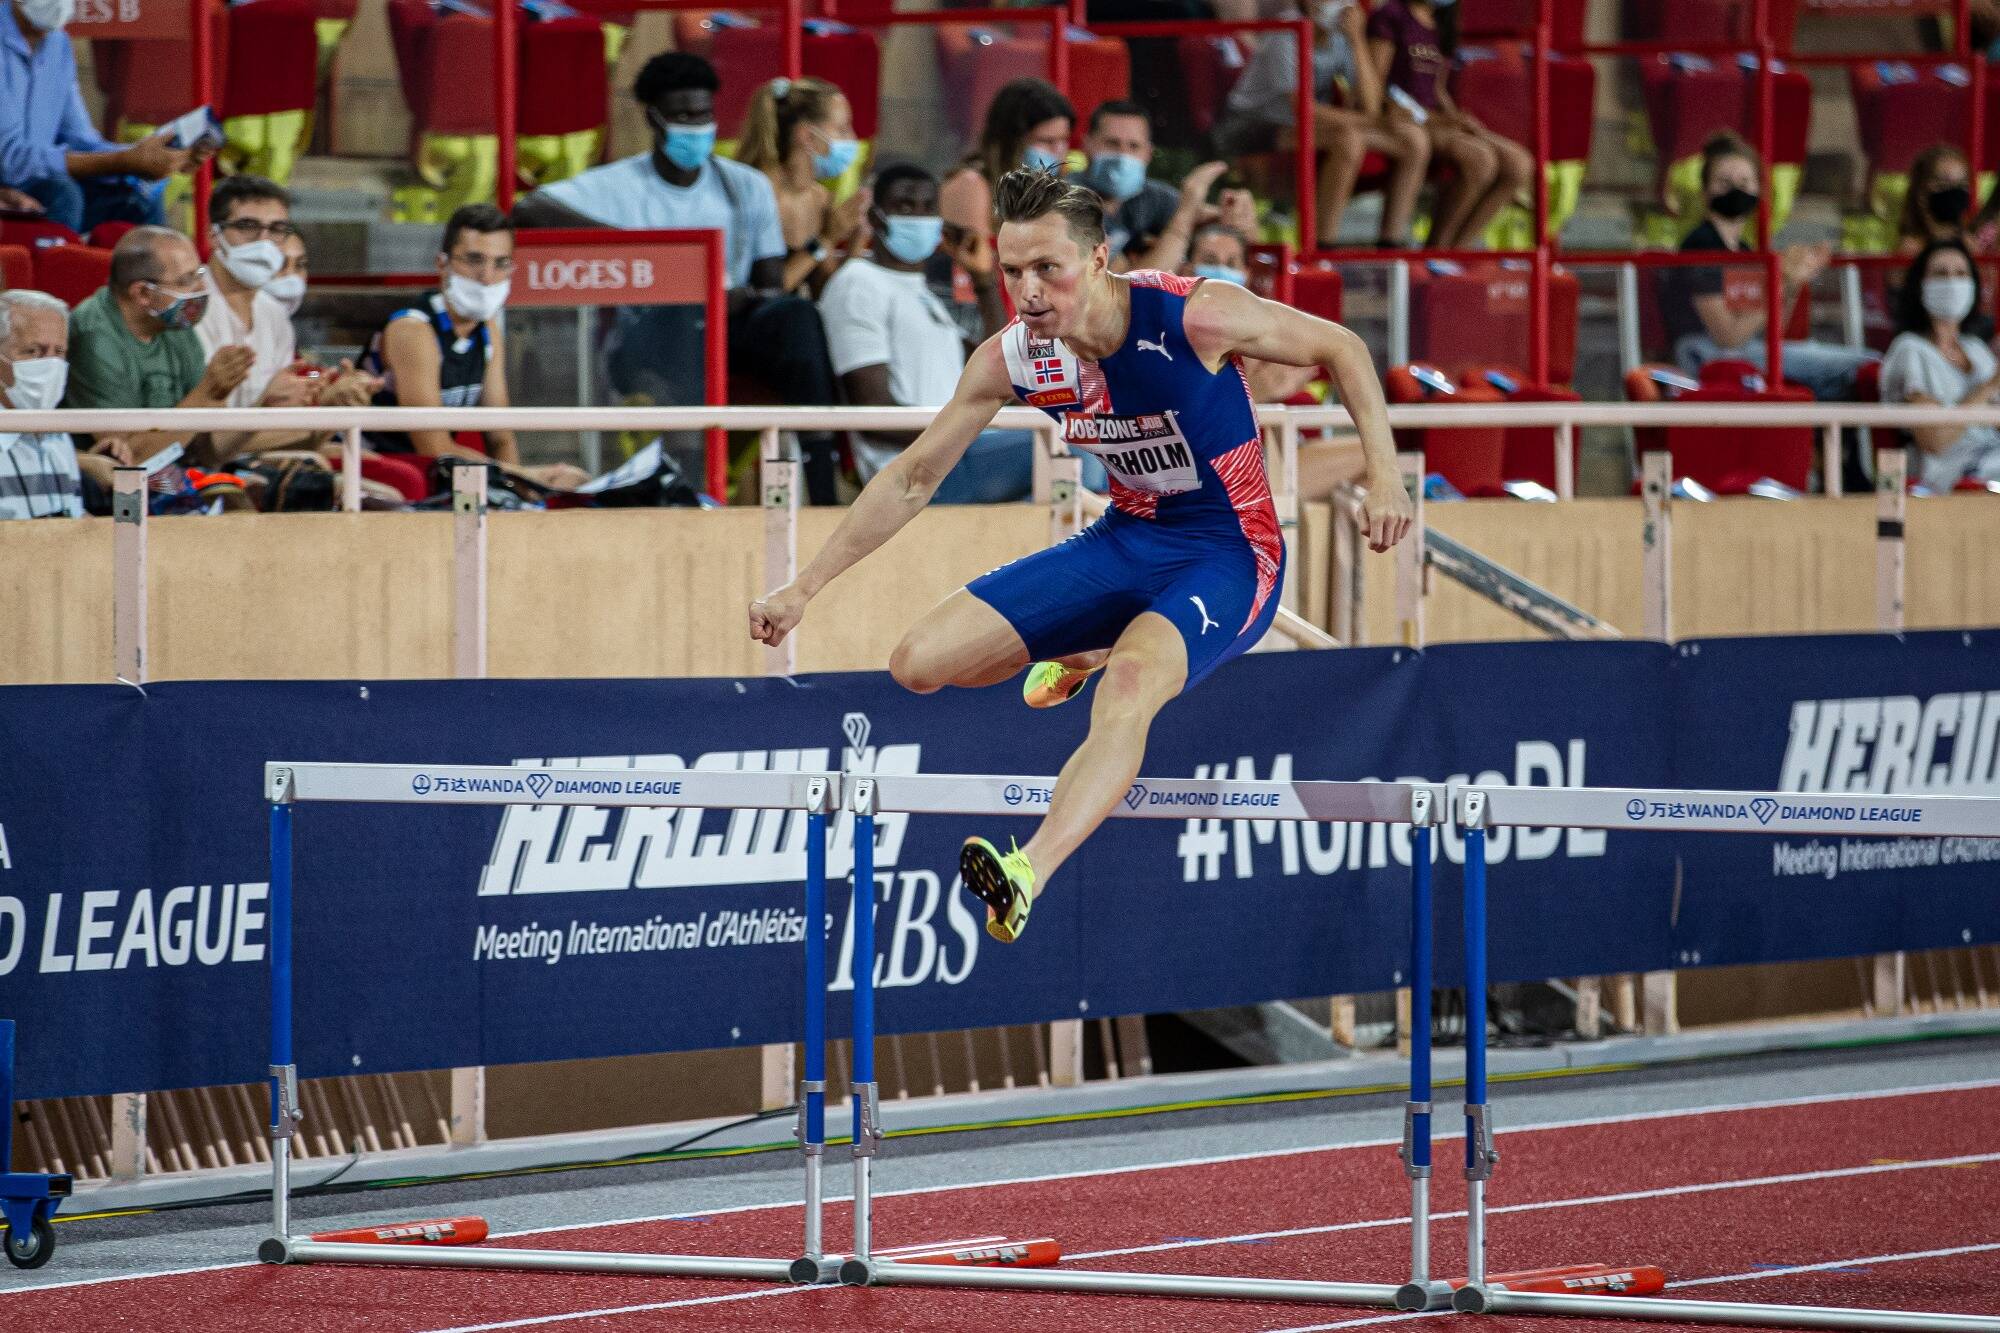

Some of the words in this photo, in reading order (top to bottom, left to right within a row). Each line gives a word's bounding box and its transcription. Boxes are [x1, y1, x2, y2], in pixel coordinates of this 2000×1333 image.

[528, 259, 627, 290] LOGES
[631, 259, 654, 288] B
[1029, 346, 1055, 358] ZONE
[1046, 392, 1073, 401] EXTRA
[1141, 416, 1163, 429] JOB
[1143, 428, 1171, 439] ZONE
[1097, 442, 1191, 476] RHOLM
[554, 781, 622, 794] DIAMOND
[625, 782, 682, 795] LEAGUE
[1149, 792, 1218, 806] DIAMOND
[1222, 793, 1281, 807] LEAGUE
[1781, 806, 1855, 821] DIAMOND
[1860, 807, 1922, 822] LEAGUE
[1773, 838, 1838, 880] Meeting
[39, 882, 270, 974] LEAGUE
[473, 922, 563, 965] Meeting
[566, 911, 707, 956] International
[705, 907, 834, 947] d'Athlétise
[826, 868, 980, 992] EBS
